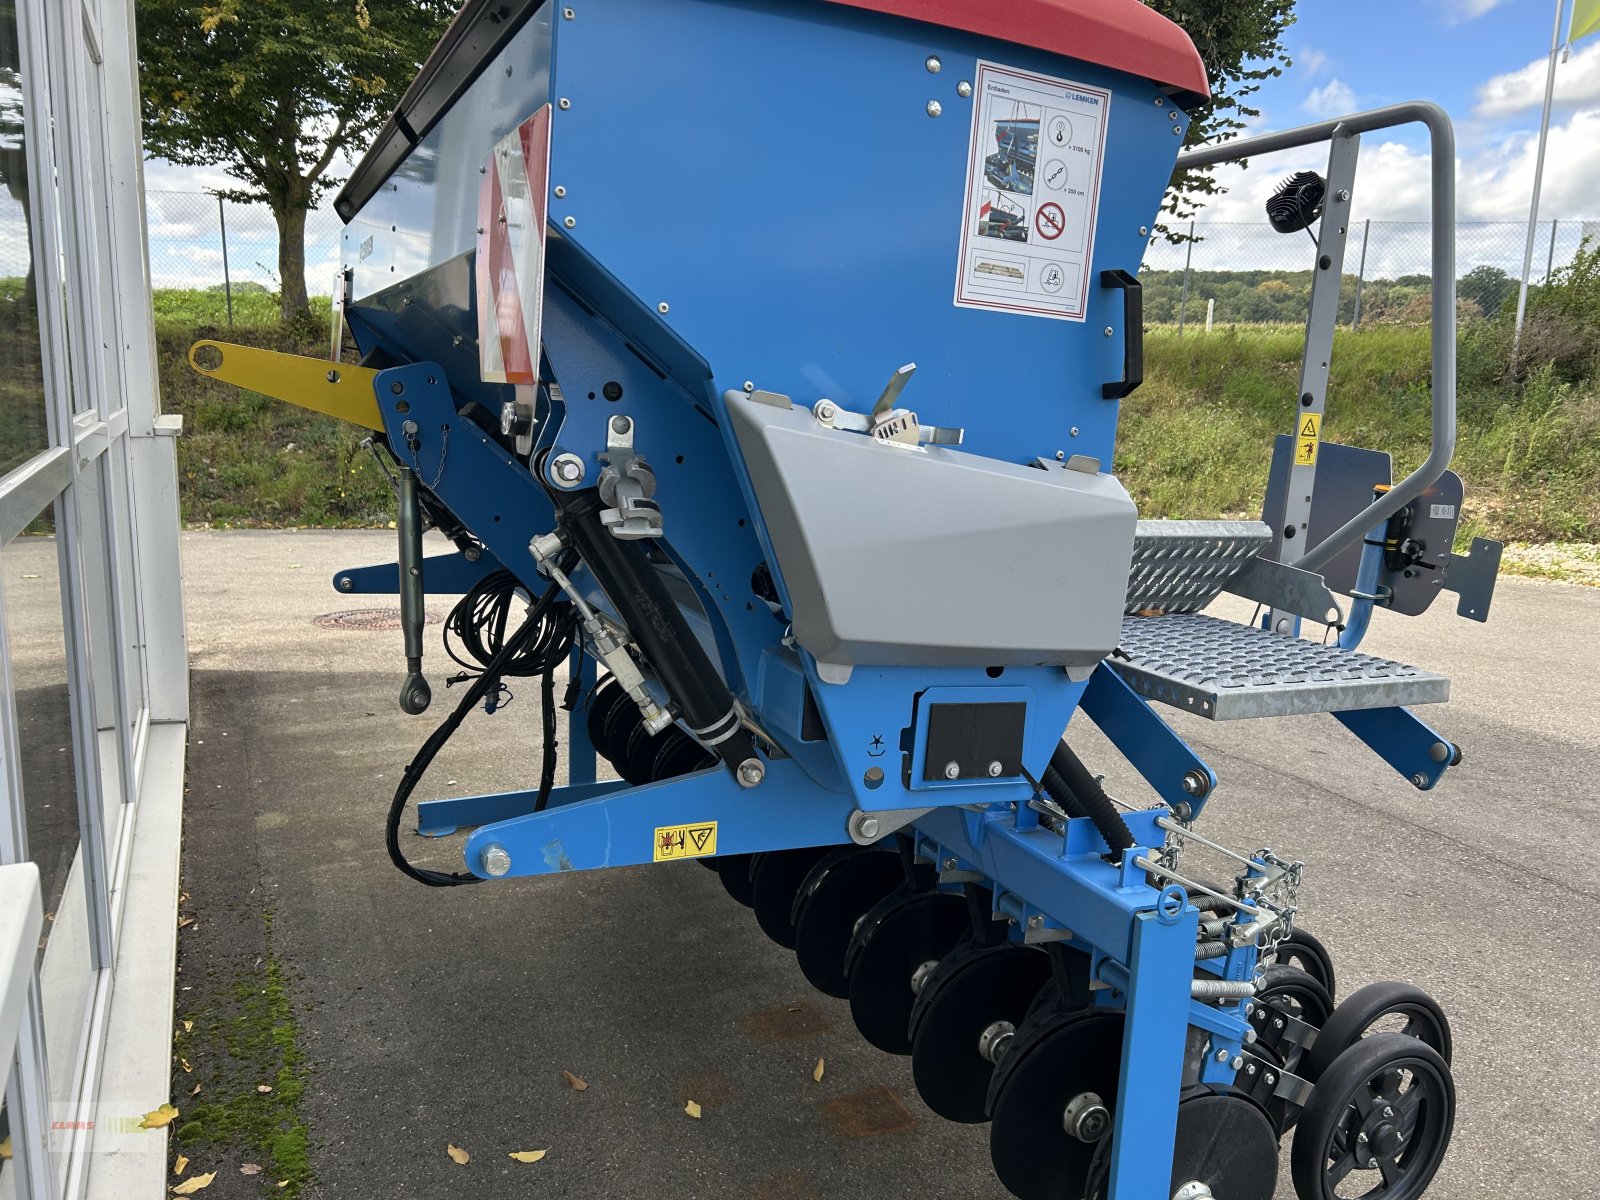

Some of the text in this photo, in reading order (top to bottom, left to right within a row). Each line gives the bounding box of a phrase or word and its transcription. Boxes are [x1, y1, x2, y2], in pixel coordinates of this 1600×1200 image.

[987, 83, 1010, 95] Entladen
[1071, 93, 1099, 106] LEMKEN
[1085, 148, 1091, 156] kg
